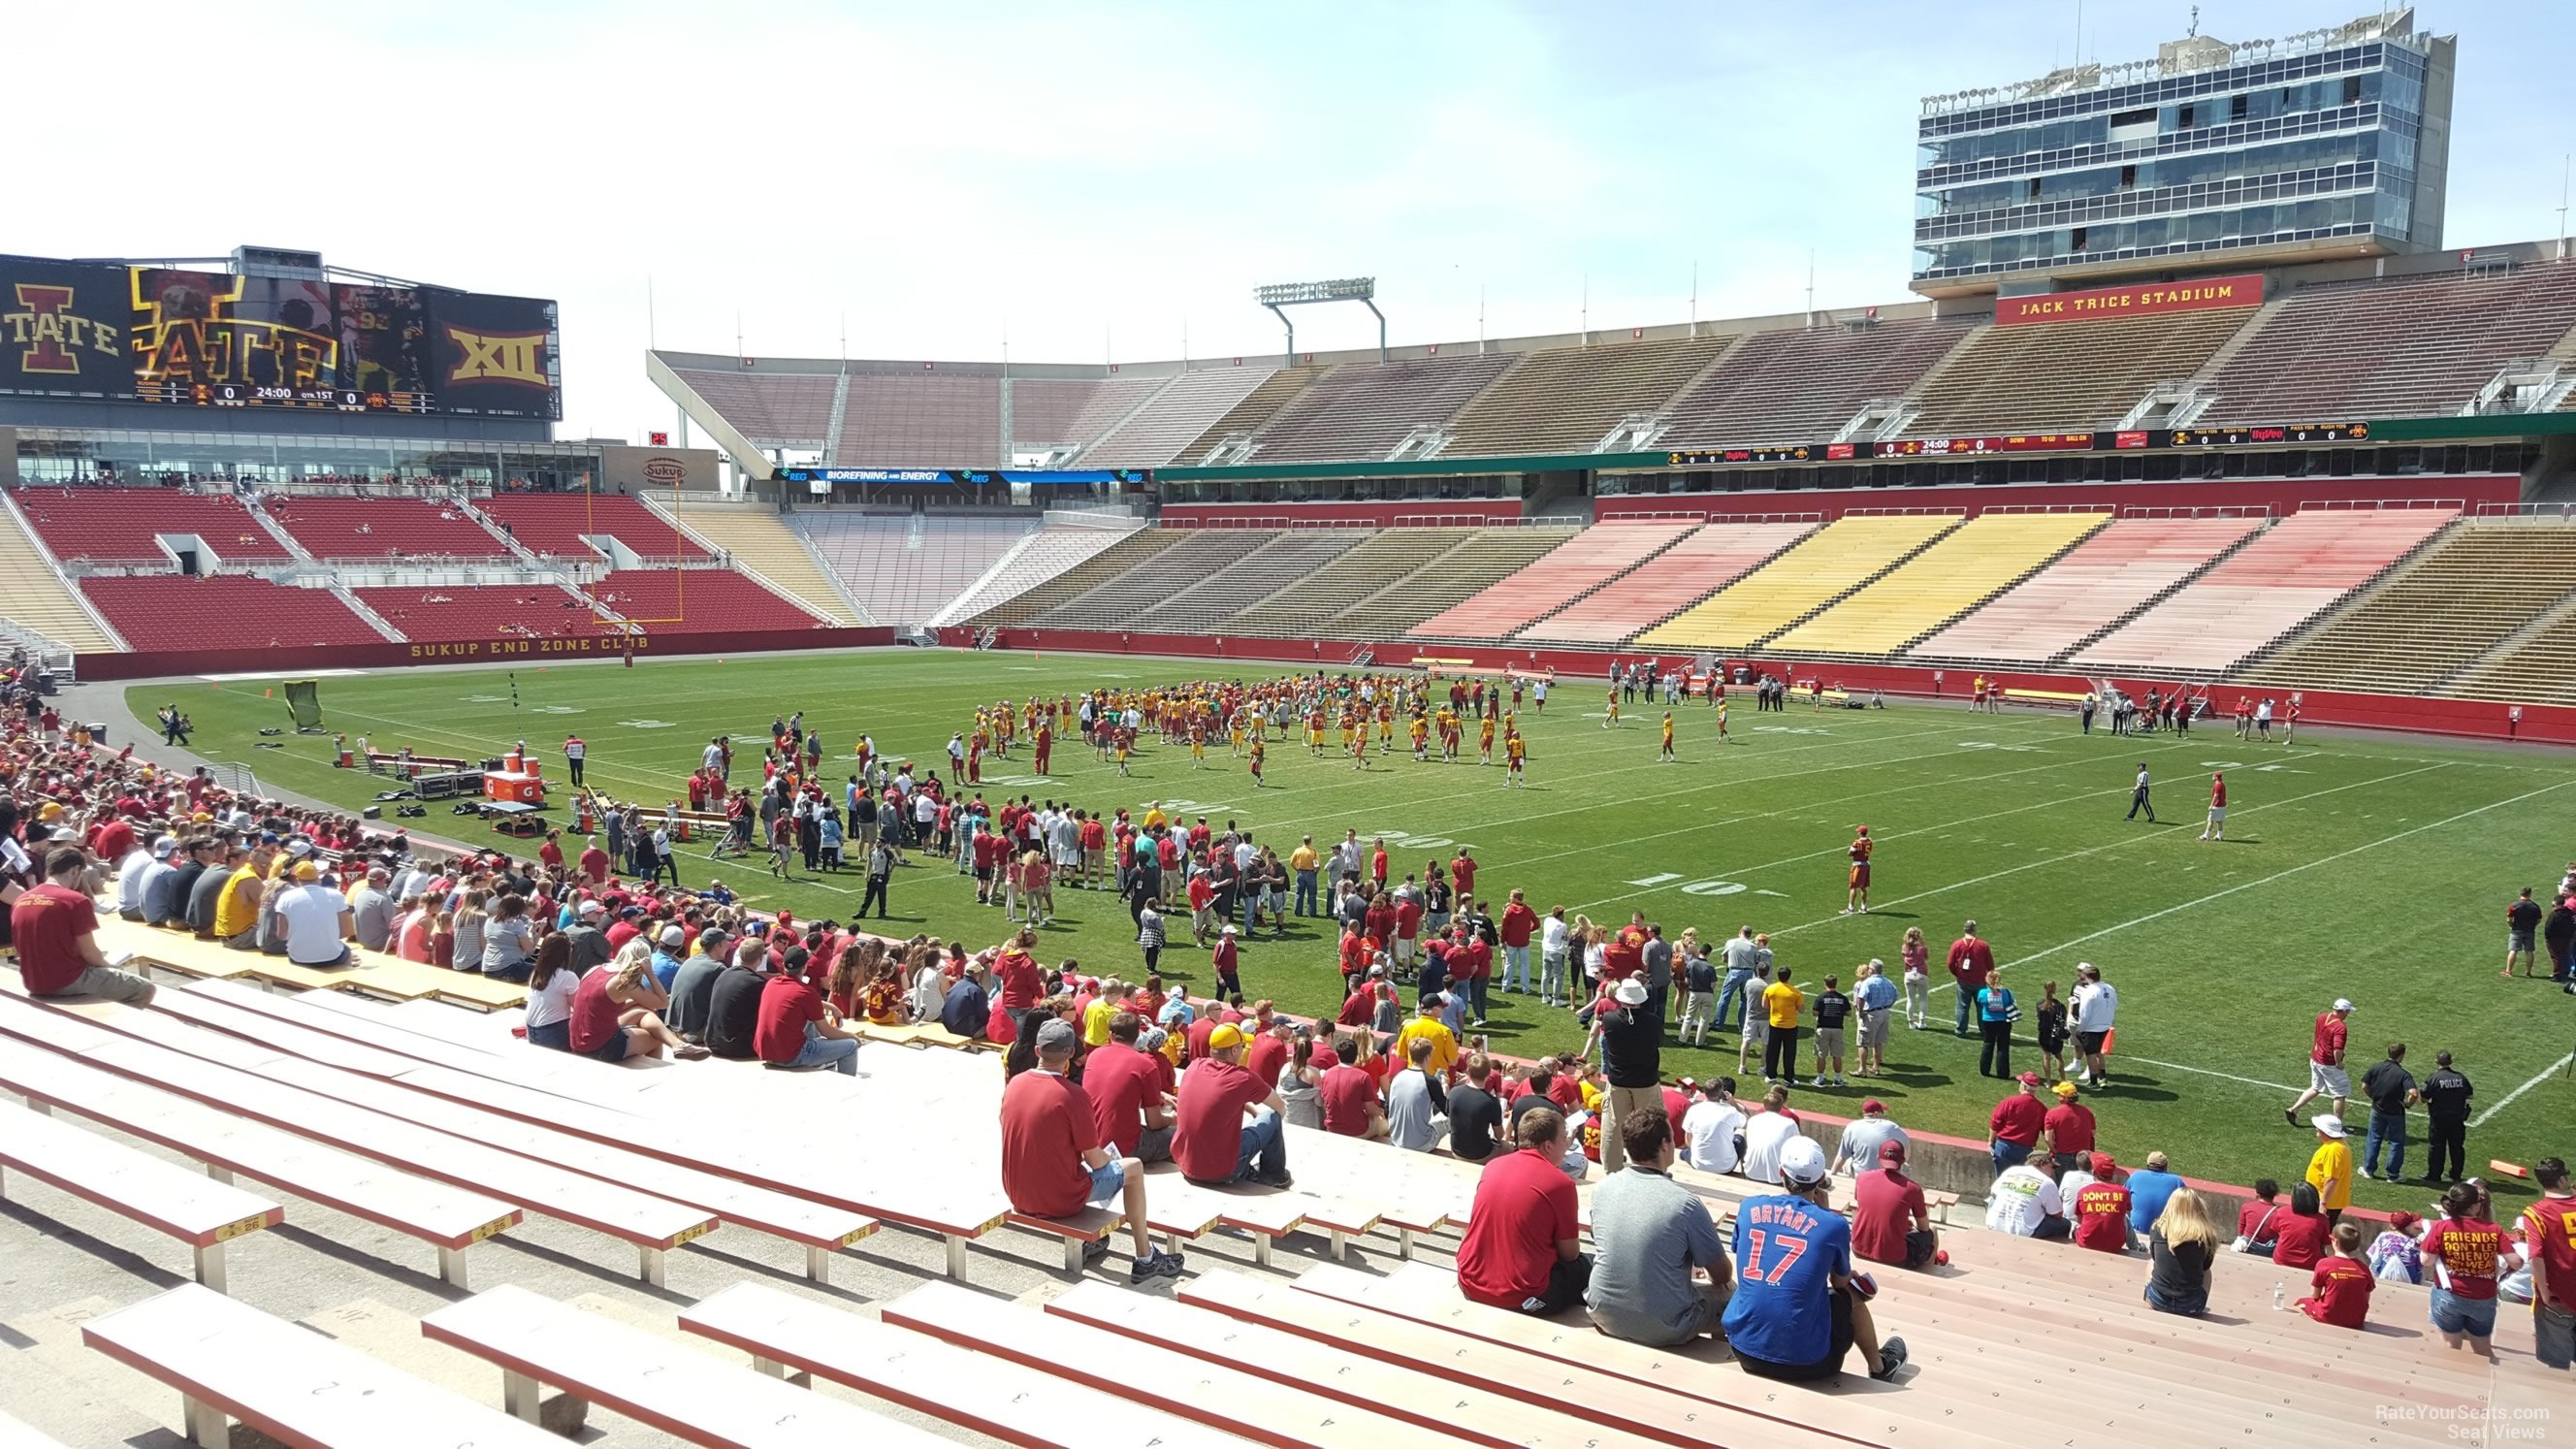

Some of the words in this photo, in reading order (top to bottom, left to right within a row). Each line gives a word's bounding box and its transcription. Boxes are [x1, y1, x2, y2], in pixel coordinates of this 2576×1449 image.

[2020, 301, 2064, 315] JACK
[2075, 295, 2130, 310] TRICE
[2141, 285, 2233, 306] STADIUM
[0, 312, 119, 357] TATE
[449, 328, 547, 386] XII
[224, 388, 235, 399] 0
[257, 387, 291, 399] 24:00
[346, 393, 356, 404] 0
[653, 434, 666, 445] 25
[2201, 435, 2207, 444] 0
[2230, 435, 2237, 443] 0
[2299, 432, 2305, 440] 0
[2328, 431, 2335, 440] 0
[1886, 443, 1894, 453] 0
[1923, 439, 1949, 449] 24:00
[1976, 439, 1983, 450] 0
[647, 464, 683, 477] Sukup
[827, 471, 887, 480] BIOREFINING
[900, 471, 939, 481] ENERGY
[789, 472, 807, 481] REG
[971, 474, 989, 483] REG
[1127, 473, 1143, 482] REG
[411, 643, 480, 658] SUKUP
[491, 641, 530, 654] END
[540, 639, 591, 652] ZONE
[524, 787, 532, 796] G
[2439, 1079, 2463, 1089] POLICE
[1583, 1126, 1600, 1149] 52
[2082, 1192, 2110, 1203] DON'T
[2112, 1192, 2124, 1202] BE
[2086, 1203, 2093, 1212] A
[1750, 1205, 1819, 1235] BRYANT
[244, 1221, 259, 1232] 26
[2443, 1232, 2497, 1243] FRIENDS
[2481, 1243, 2497, 1252] LET
[1743, 1229, 1807, 1283] 17
